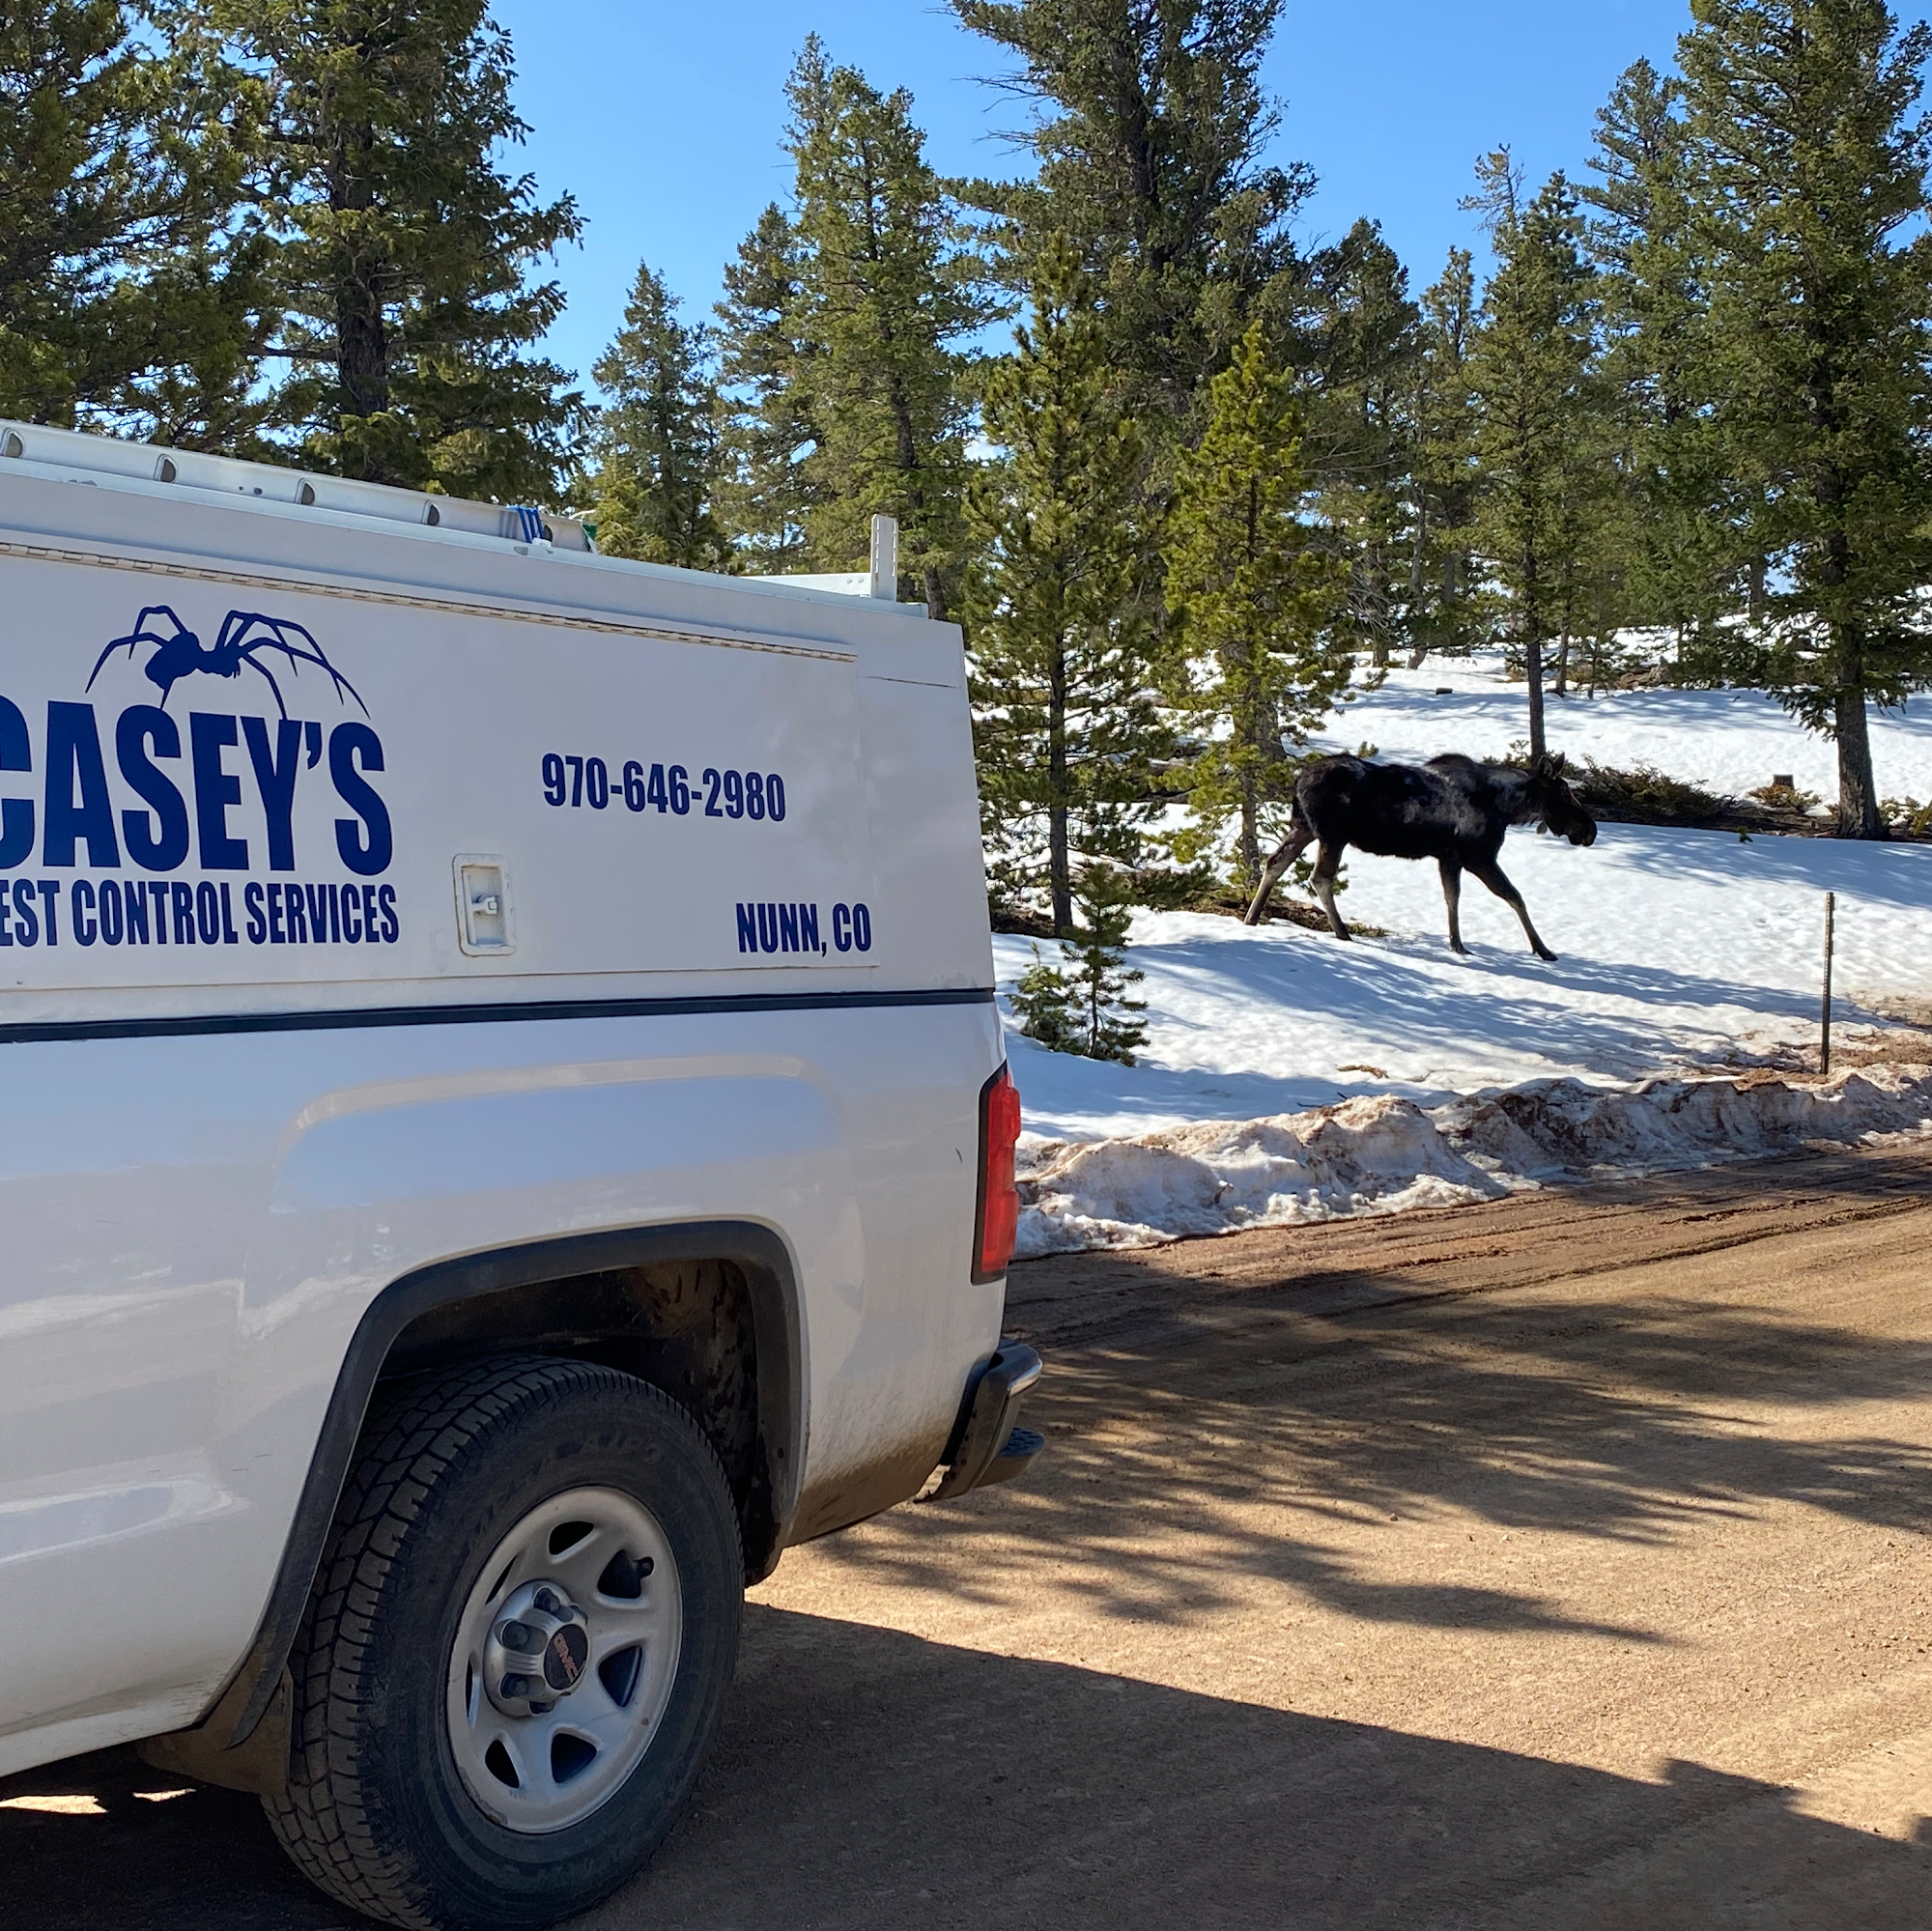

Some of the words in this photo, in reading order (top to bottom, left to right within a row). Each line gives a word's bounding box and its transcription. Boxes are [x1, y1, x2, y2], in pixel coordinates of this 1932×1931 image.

[542, 753, 786, 822] 970-646-2980
[71, 879, 239, 947] CONTROL
[244, 881, 399, 945] SERVICES
[735, 902, 827, 957] NUNN,
[833, 902, 872, 952] CO
[554, 1633, 580, 1684] GMC
